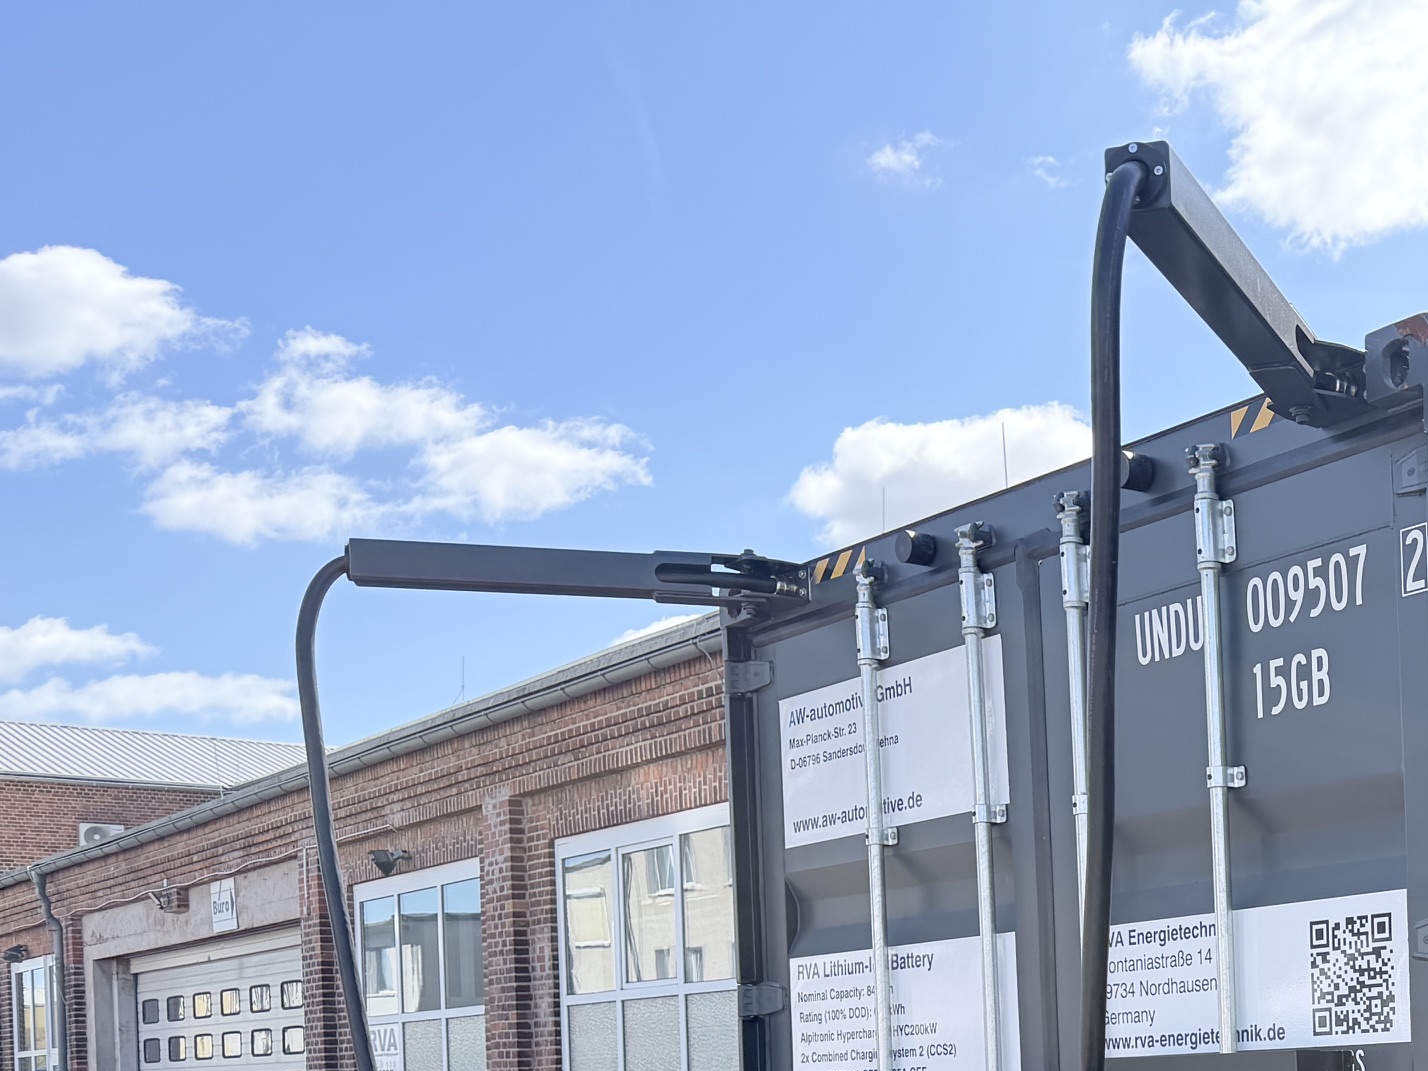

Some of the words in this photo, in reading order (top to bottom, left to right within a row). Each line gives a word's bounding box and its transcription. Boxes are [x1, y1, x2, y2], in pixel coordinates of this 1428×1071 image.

[1134, 595, 1204, 666] UNDU
[1246, 543, 1367, 633] 009507
[1405, 529, 1426, 592] 2
[1253, 647, 1330, 719] 15GB
[789, 693, 864, 727] AW-automotiv
[876, 677, 912, 702] GmbH
[789, 726, 847, 749] Max-Planck-Str.
[848, 723, 857, 736] 23
[790, 753, 821, 770] D-06796
[793, 791, 923, 834] www.aw-autotive.de
[1108, 931, 1124, 948] VA
[1128, 921, 1216, 948] Energietechn
[797, 961, 820, 980] RVA
[824, 957, 874, 977] Lithium-I
[891, 952, 934, 973] Battery
[1108, 950, 1193, 974] ontaniastraße
[1197, 948, 1213, 965] 14
[797, 988, 828, 1003] Nominal
[829, 986, 865, 1003] Capacity:
[1105, 981, 1136, 1000] 9734
[1139, 976, 1218, 998] Nordhausen
[799, 1008, 822, 1024] Rating
[824, 1008, 847, 1023] (100%
[848, 1006, 872, 1021] DOD):
[370, 1028, 398, 1052] RVA
[800, 1029, 835, 1045] Alpitronic
[836, 1027, 877, 1043] Hyperchar
[893, 1022, 937, 1037] HYC200kW
[1104, 1022, 1286, 1051] www.rva-energietenik.de
[801, 1052, 810, 1064] 2x
[811, 1049, 849, 1063] Combined
[850, 1047, 878, 1062] Chargi
[892, 1045, 917, 1060] ystem
[919, 1045, 925, 1057] 2
[926, 1043, 957, 1058] (CCS2)
